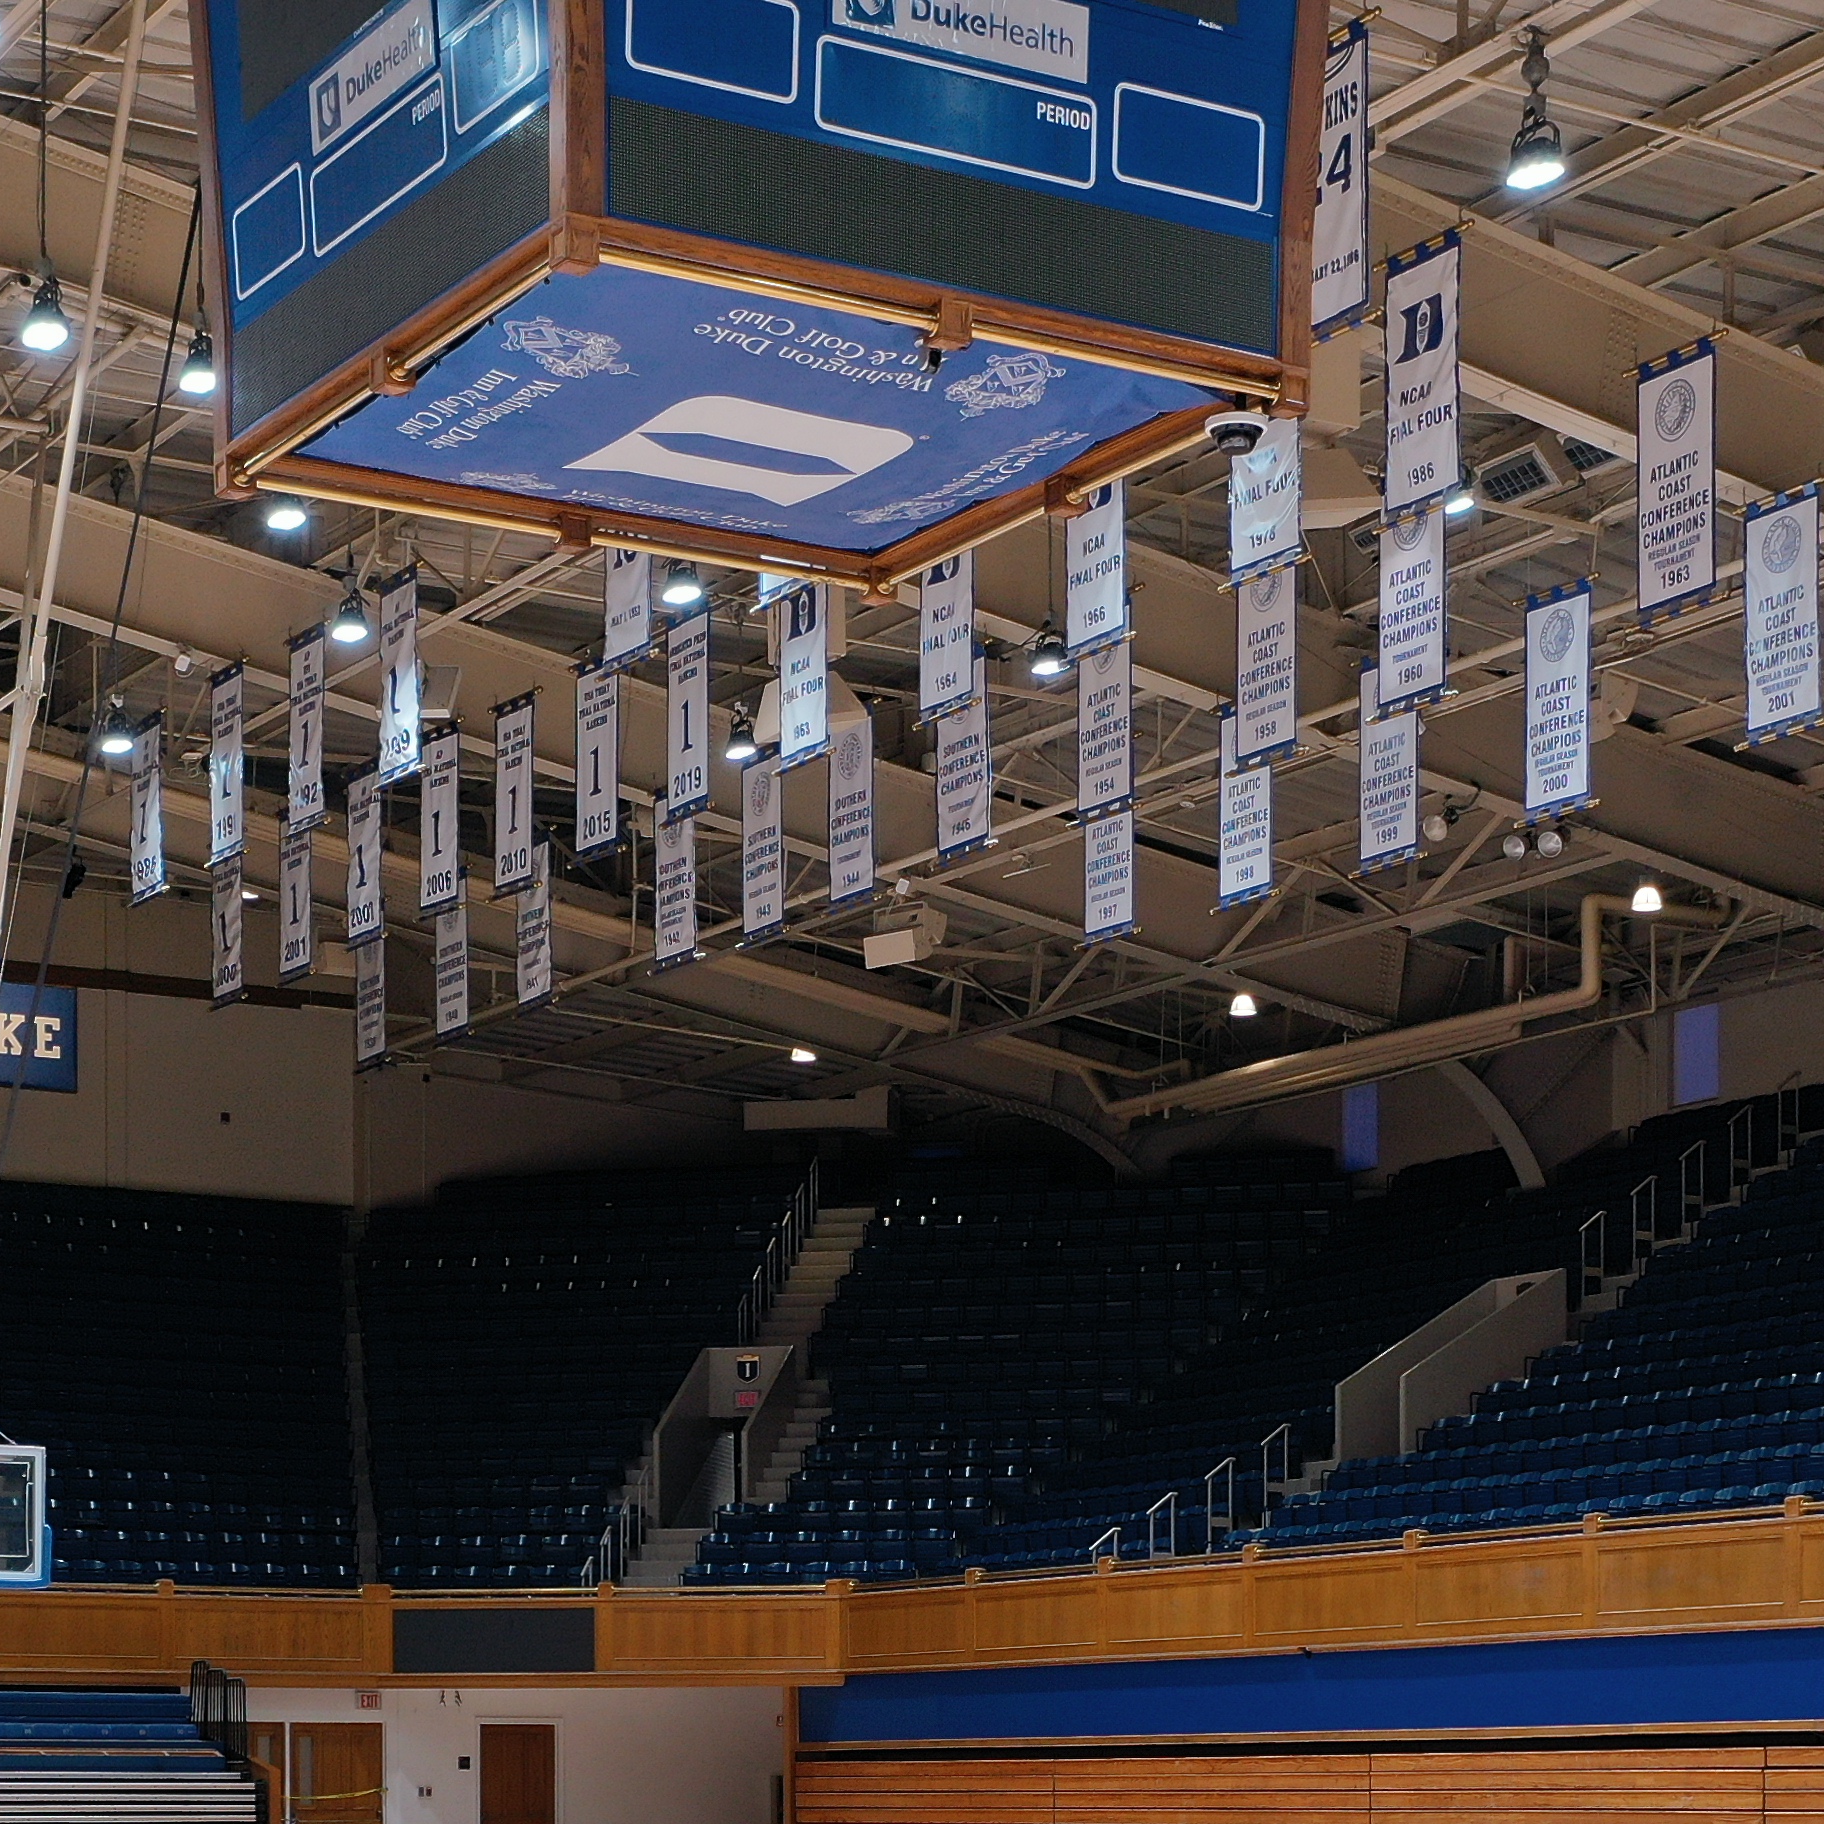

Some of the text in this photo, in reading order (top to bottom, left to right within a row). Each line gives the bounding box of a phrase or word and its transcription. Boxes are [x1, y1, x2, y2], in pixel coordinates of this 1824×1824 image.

[910, 0, 1074, 58] DukeHealth
[412, 89, 441, 125] PERIOD
[1037, 102, 1089, 130] PERIOD
[1325, 81, 1358, 132] KINS
[693, 323, 774, 356] Duke
[794, 328, 865, 358] Golf
[778, 345, 933, 392] Washington
[868, 350, 897, 365] &
[472, 368, 519, 392] Inn
[1399, 380, 1432, 407] NCAA
[425, 379, 562, 449] Washington Duke
[428, 395, 474, 418] Golf
[1417, 403, 1453, 430] FOUR
[1407, 461, 1435, 488] 1986
[1650, 450, 1699, 484] ATLANTIC
[1659, 474, 1692, 502] COAST
[1641, 489, 1710, 530] CONFERENCE
[1082, 532, 1106, 558] NCAA
[1643, 512, 1707, 550] CHAMPIONS
[1095, 554, 1121, 580] FOUR
[1388, 559, 1432, 588] ATLANTIC
[1660, 565, 1691, 590] 1963
[1395, 581, 1426, 605] COAST
[1758, 584, 1805, 615] ATLANTIC
[1083, 605, 1106, 629] 1966
[1380, 595, 1441, 631] CONFERENCE
[1765, 607, 1797, 632] COAST
[1247, 621, 1286, 649] ATLANTIC
[1382, 616, 1438, 650] CHAMPIONS
[1253, 642, 1279, 664] COAST
[1750, 642, 1814, 675] CHAMPIONS
[801, 675, 824, 696] FOUR
[1239, 655, 1293, 688] CONFERENCE
[1397, 663, 1423, 686] 1960
[389, 665, 400, 715] 1
[1087, 682, 1121, 709] ATLANTIC
[1241, 675, 1290, 706] CHAMPIONS
[1535, 675, 1577, 701] ATLANTIC
[1767, 690, 1795, 714] 2001
[1093, 702, 1115, 724] COAST
[1541, 695, 1571, 717] COAST
[681, 699, 693, 753] 1
[1080, 715, 1128, 746] CONFERENCE
[1254, 720, 1277, 742] 1958
[1529, 710, 1585, 741] CONFERENCE
[299, 720, 309, 768] 1
[1082, 734, 1126, 763] CHAMPIONS
[1368, 732, 1406, 757] ATLANTIC
[1531, 729, 1582, 758] CHAMPIONS
[589, 745, 602, 797] 1
[939, 750, 985, 779] CONFERENCE
[1374, 752, 1401, 772] COAST
[673, 765, 702, 799] 2019
[940, 769, 983, 796] CHAMPIONS
[1093, 776, 1115, 797] 1954
[1228, 776, 1261, 800] ATLANTIC
[1362, 765, 1414, 794] CONFERENCE
[1543, 773, 1568, 794] 2000
[507, 784, 518, 835] 1
[1232, 795, 1256, 815] COAST
[1363, 783, 1411, 811] CHAMPIONS
[431, 810, 443, 858] 1
[583, 809, 611, 841] 2015
[1091, 819, 1124, 841] ATLANTIC
[1222, 808, 1269, 835] CONFERENCE
[1376, 826, 1398, 845] 1999
[1096, 837, 1119, 855] COAST
[1223, 826, 1267, 851] CHAMPIONS
[355, 843, 367, 889] 1
[500, 847, 527, 877] 2010
[1087, 849, 1131, 874] CONFERENCE
[1235, 865, 1255, 884] 1998
[426, 869, 452, 898] 2006
[290, 882, 299, 926] 1
[219, 911, 231, 953] 1
[361, 1693, 380, 1708] EXIT
